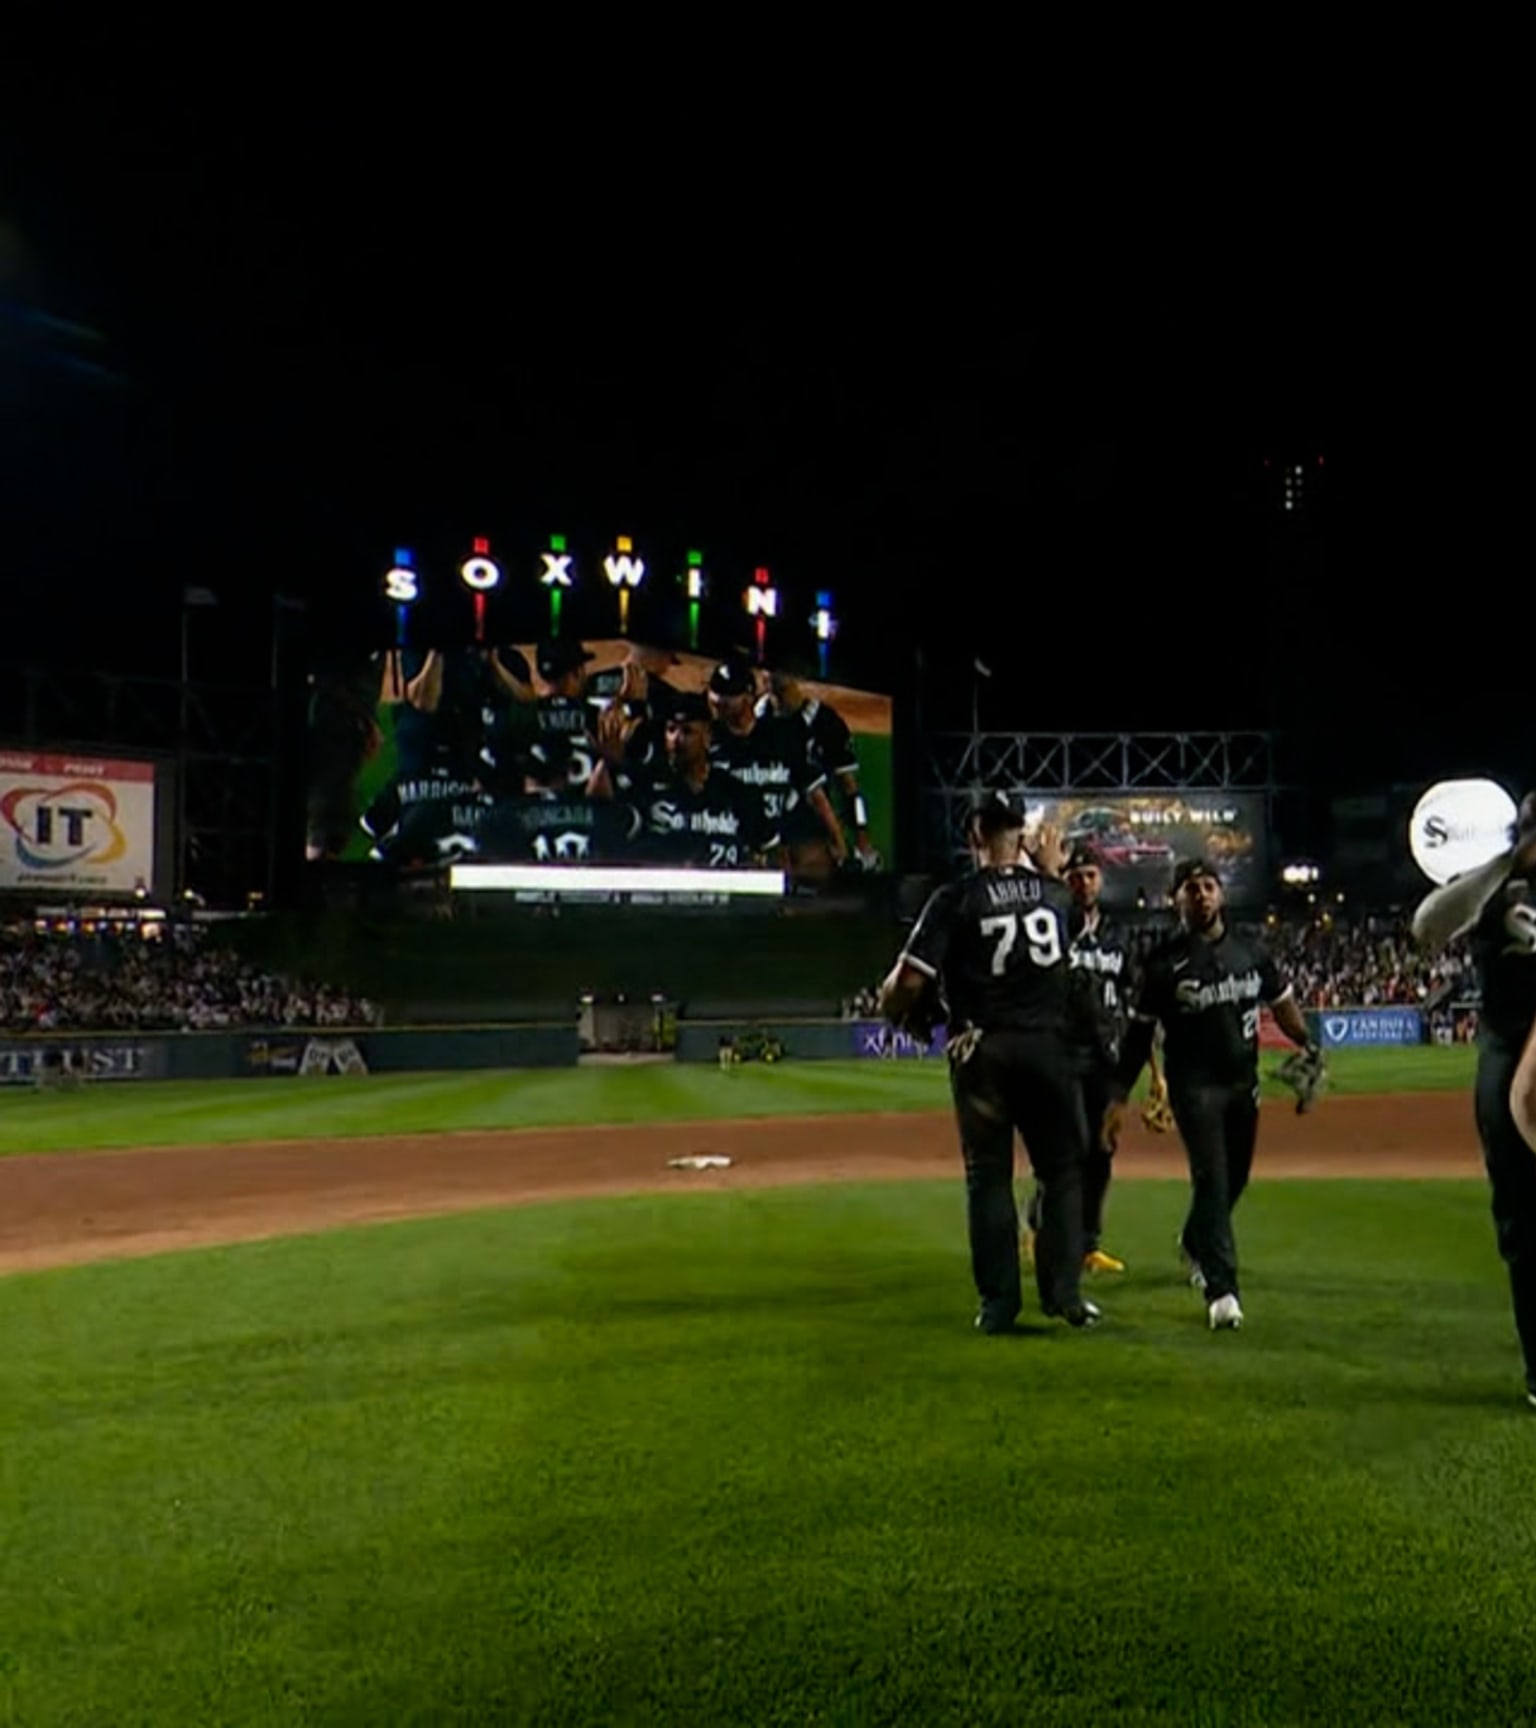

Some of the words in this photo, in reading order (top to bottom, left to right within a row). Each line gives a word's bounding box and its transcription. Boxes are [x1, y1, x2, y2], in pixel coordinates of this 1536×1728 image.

[397, 777, 474, 804] HARRISO
[711, 759, 791, 787] Suthside
[36, 804, 93, 847] IT
[980, 906, 1063, 977] 79
